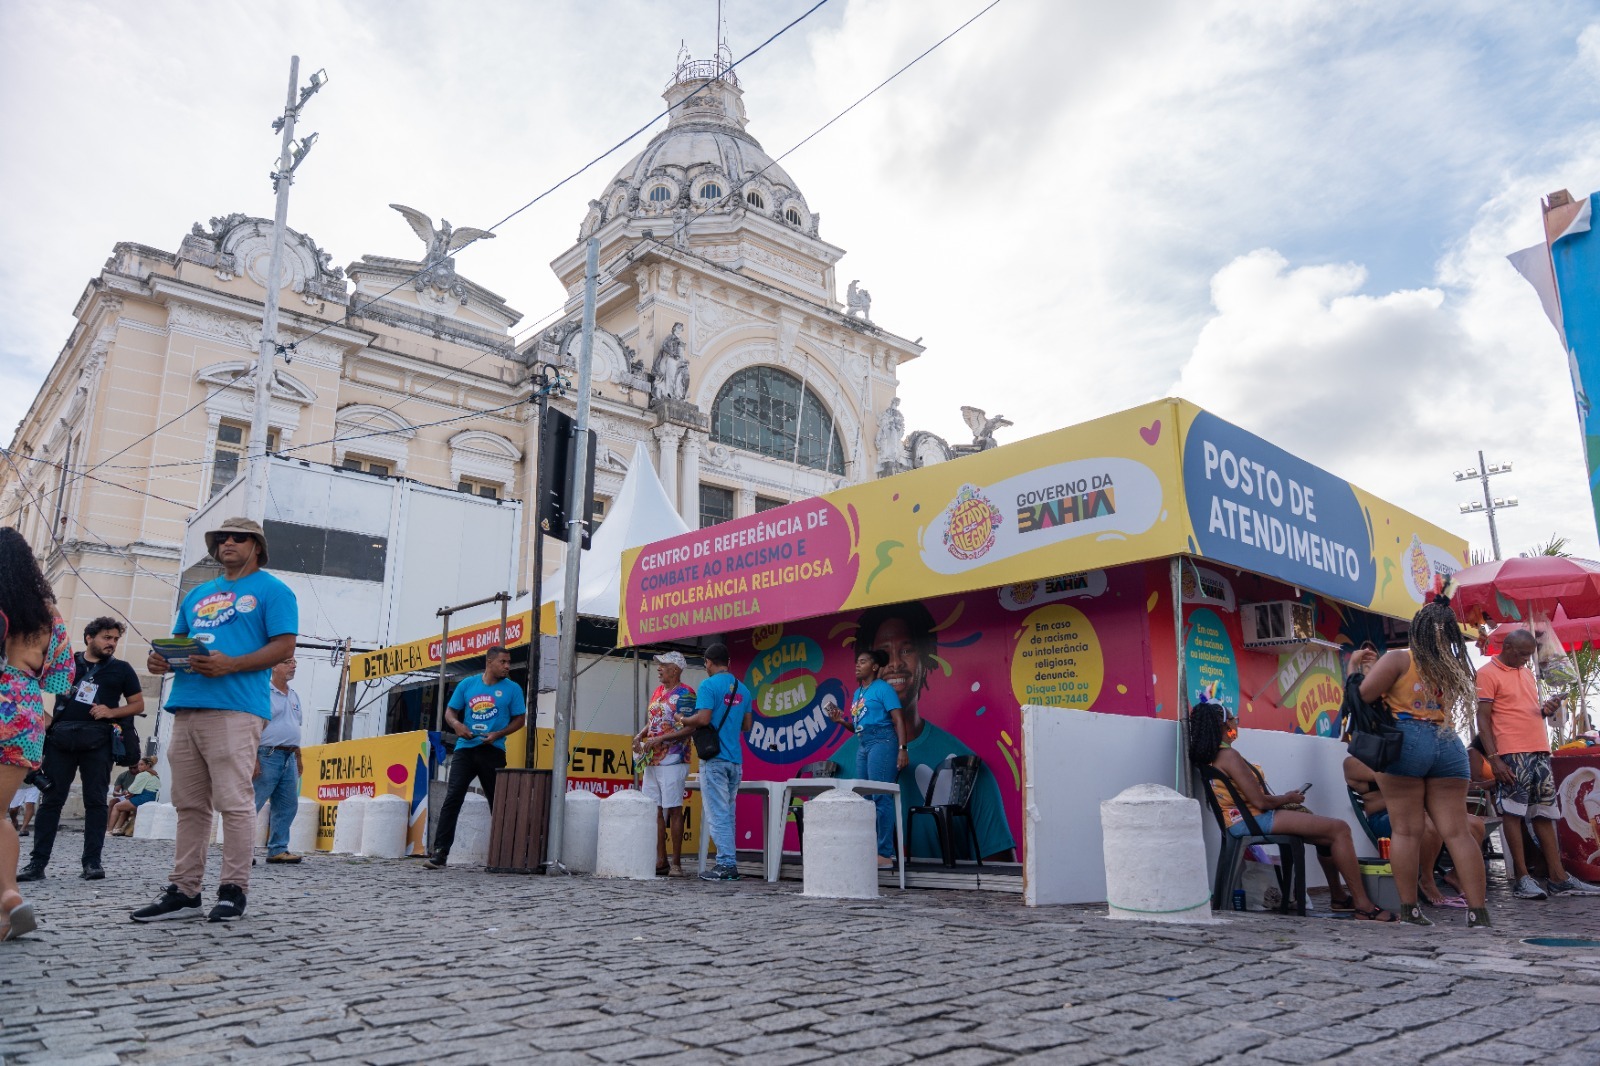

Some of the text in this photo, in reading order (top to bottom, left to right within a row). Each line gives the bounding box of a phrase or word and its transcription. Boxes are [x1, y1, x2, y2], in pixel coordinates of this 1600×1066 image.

[1016, 473, 1113, 507] GOVERNO DA
[1203, 440, 1317, 523] POSTO DE
[950, 503, 991, 535] ESTADO
[1017, 487, 1116, 534] BAHIA
[641, 508, 829, 571] CENTRO DE REFERÊNCIA DE
[952, 518, 992, 551] ALEGRIA
[1209, 495, 1360, 582] ATENDIMENTO
[640, 539, 807, 592] COMBATE AO RACISMO E
[640, 558, 834, 613] À INTOLERÂNCIA RELIGIOSA
[193, 608, 235, 628] RACISMO
[639, 598, 761, 634] NELSON MANDELA
[1035, 620, 1071, 632] Em caso
[1197, 624, 1219, 637] Em caso
[476, 627, 500, 648] BAHIA
[754, 622, 779, 646] AQUI
[1030, 632, 1078, 645] de racismo
[1194, 636, 1224, 651] de racismo
[364, 645, 422, 678] DETRAN-BA
[751, 642, 808, 687] A FOLIA
[1022, 642, 1088, 658] ou intolerância
[1035, 657, 1077, 669] religiosa,
[1190, 650, 1231, 664] ou intolerância
[1035, 669, 1078, 682] denuncie.
[1199, 663, 1224, 678] religiosa,
[1280, 662, 1298, 692] DA
[762, 682, 807, 711] É SEM
[1026, 681, 1089, 695] Disque 100 ou
[1046, 693, 1089, 705] 3117-7448
[1300, 675, 1341, 724] DIZ NÃO
[749, 693, 838, 752] RACISMO
[320, 755, 374, 780] DETRAN-BA
